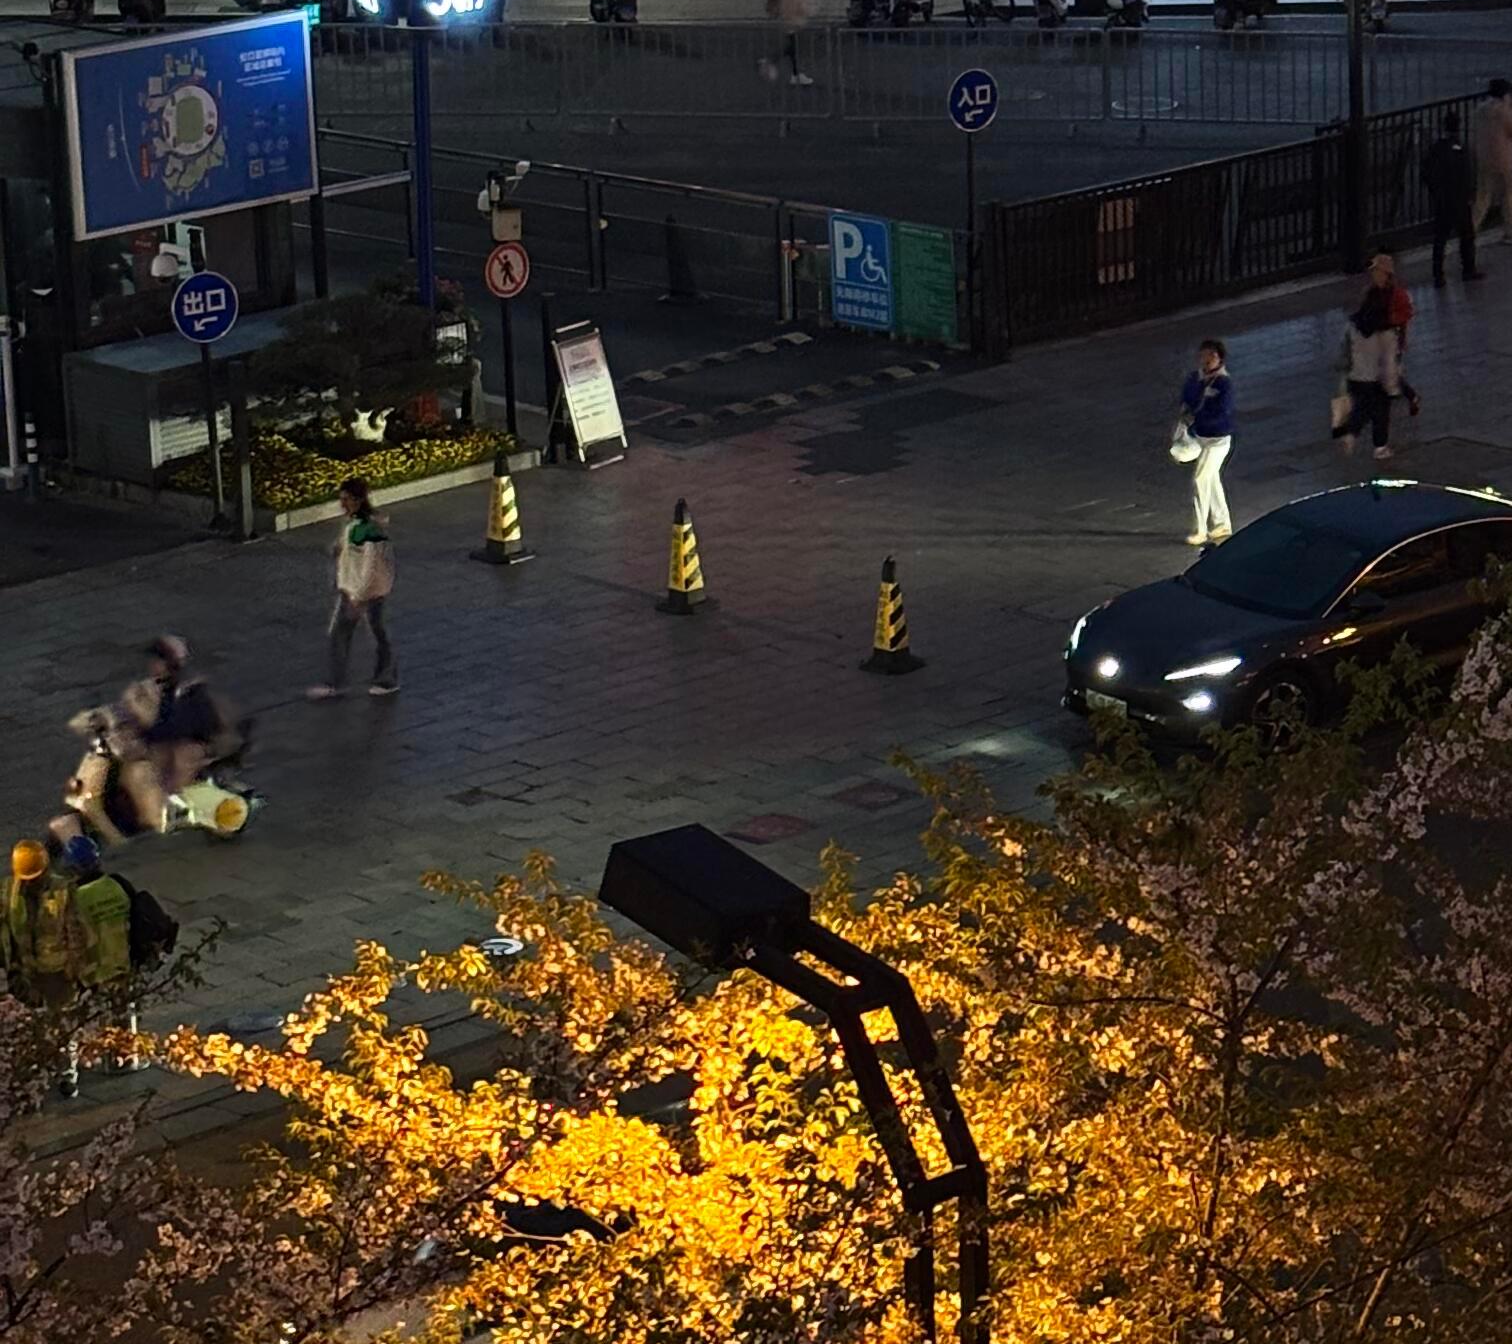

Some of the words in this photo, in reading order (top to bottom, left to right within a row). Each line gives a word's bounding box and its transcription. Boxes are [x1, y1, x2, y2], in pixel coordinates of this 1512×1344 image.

[957, 84, 991, 108] 入口
[833, 220, 863, 279] P
[182, 287, 227, 317] 出口
